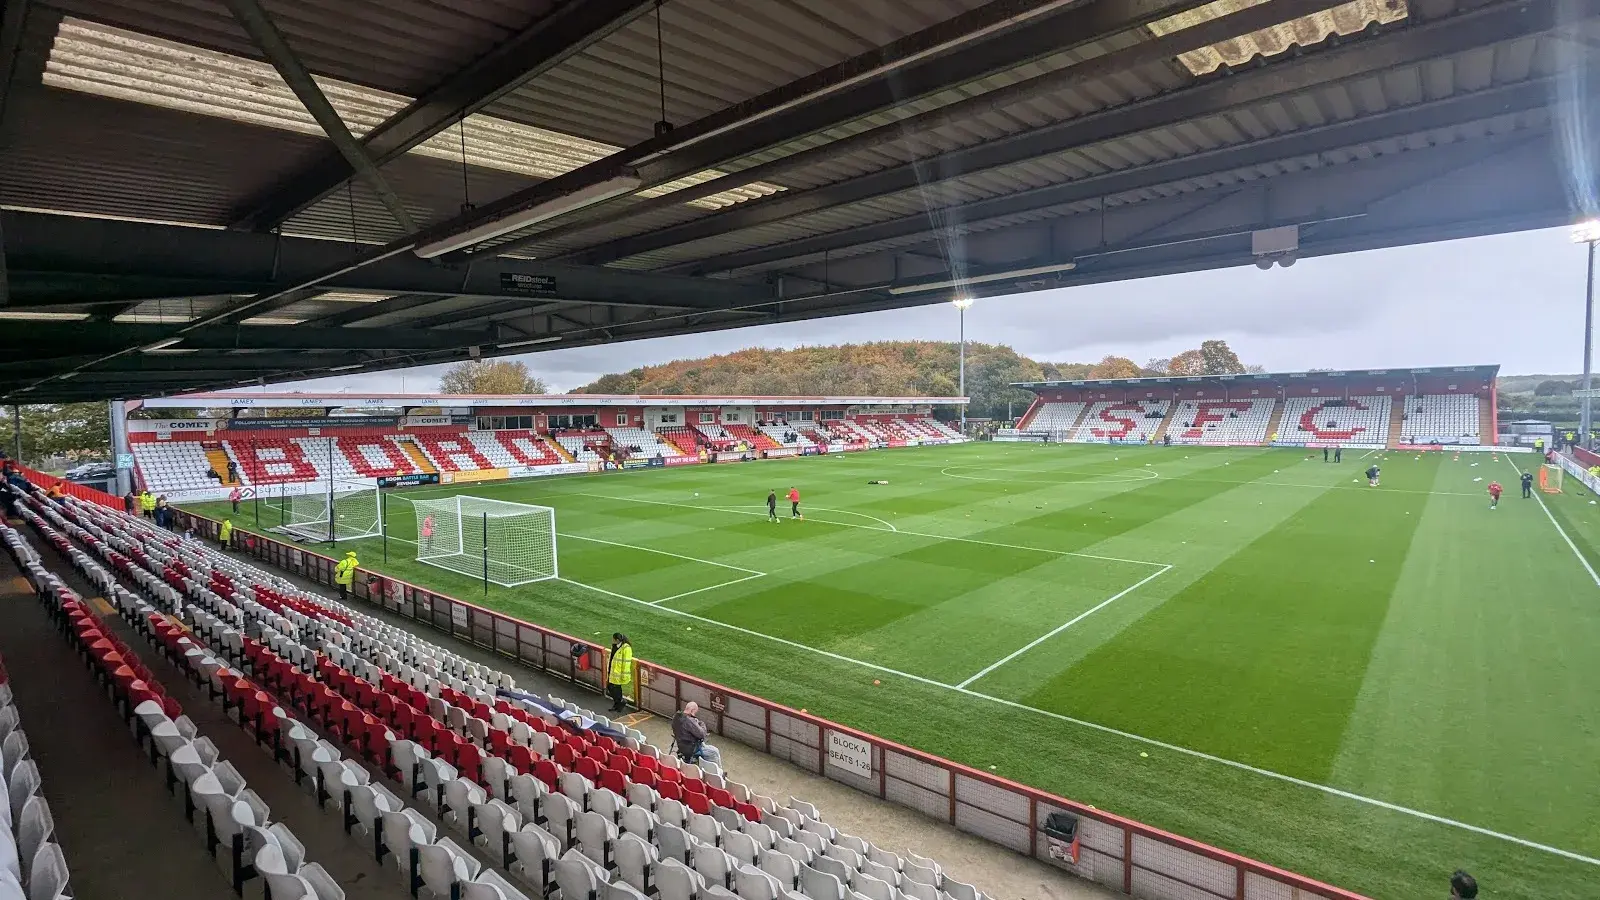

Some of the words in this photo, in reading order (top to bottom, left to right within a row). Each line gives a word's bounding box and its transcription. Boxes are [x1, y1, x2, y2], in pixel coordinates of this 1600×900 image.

[511, 274, 549, 284] REIDsteel
[833, 736, 859, 752] BLOCK
[861, 747, 867, 755] A
[829, 750, 854, 765] SEATS
[855, 759, 871, 771] 1-26
